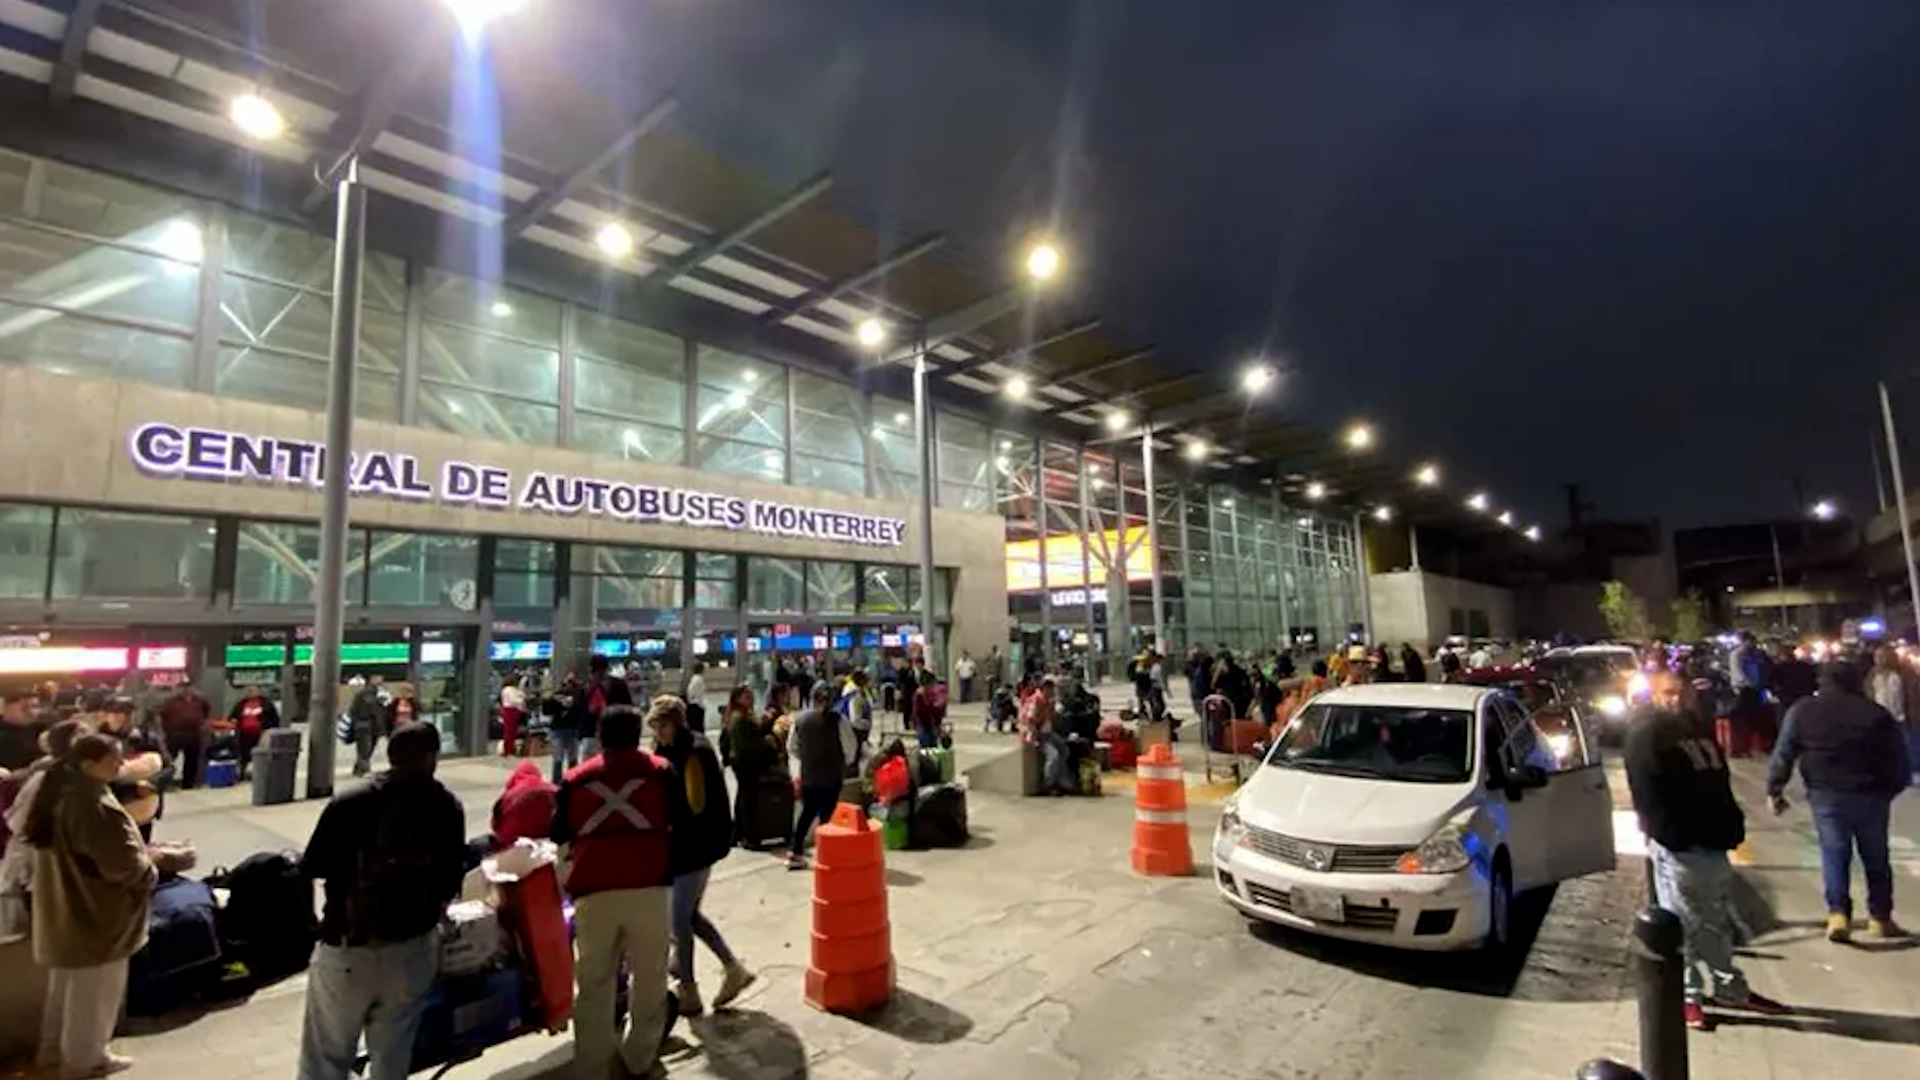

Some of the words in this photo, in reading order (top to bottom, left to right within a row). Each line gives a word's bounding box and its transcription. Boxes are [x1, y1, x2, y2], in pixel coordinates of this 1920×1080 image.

[446, 462, 509, 501] DE
[523, 475, 747, 526] AUTOBUSES
[753, 502, 906, 545] MONTERREY
